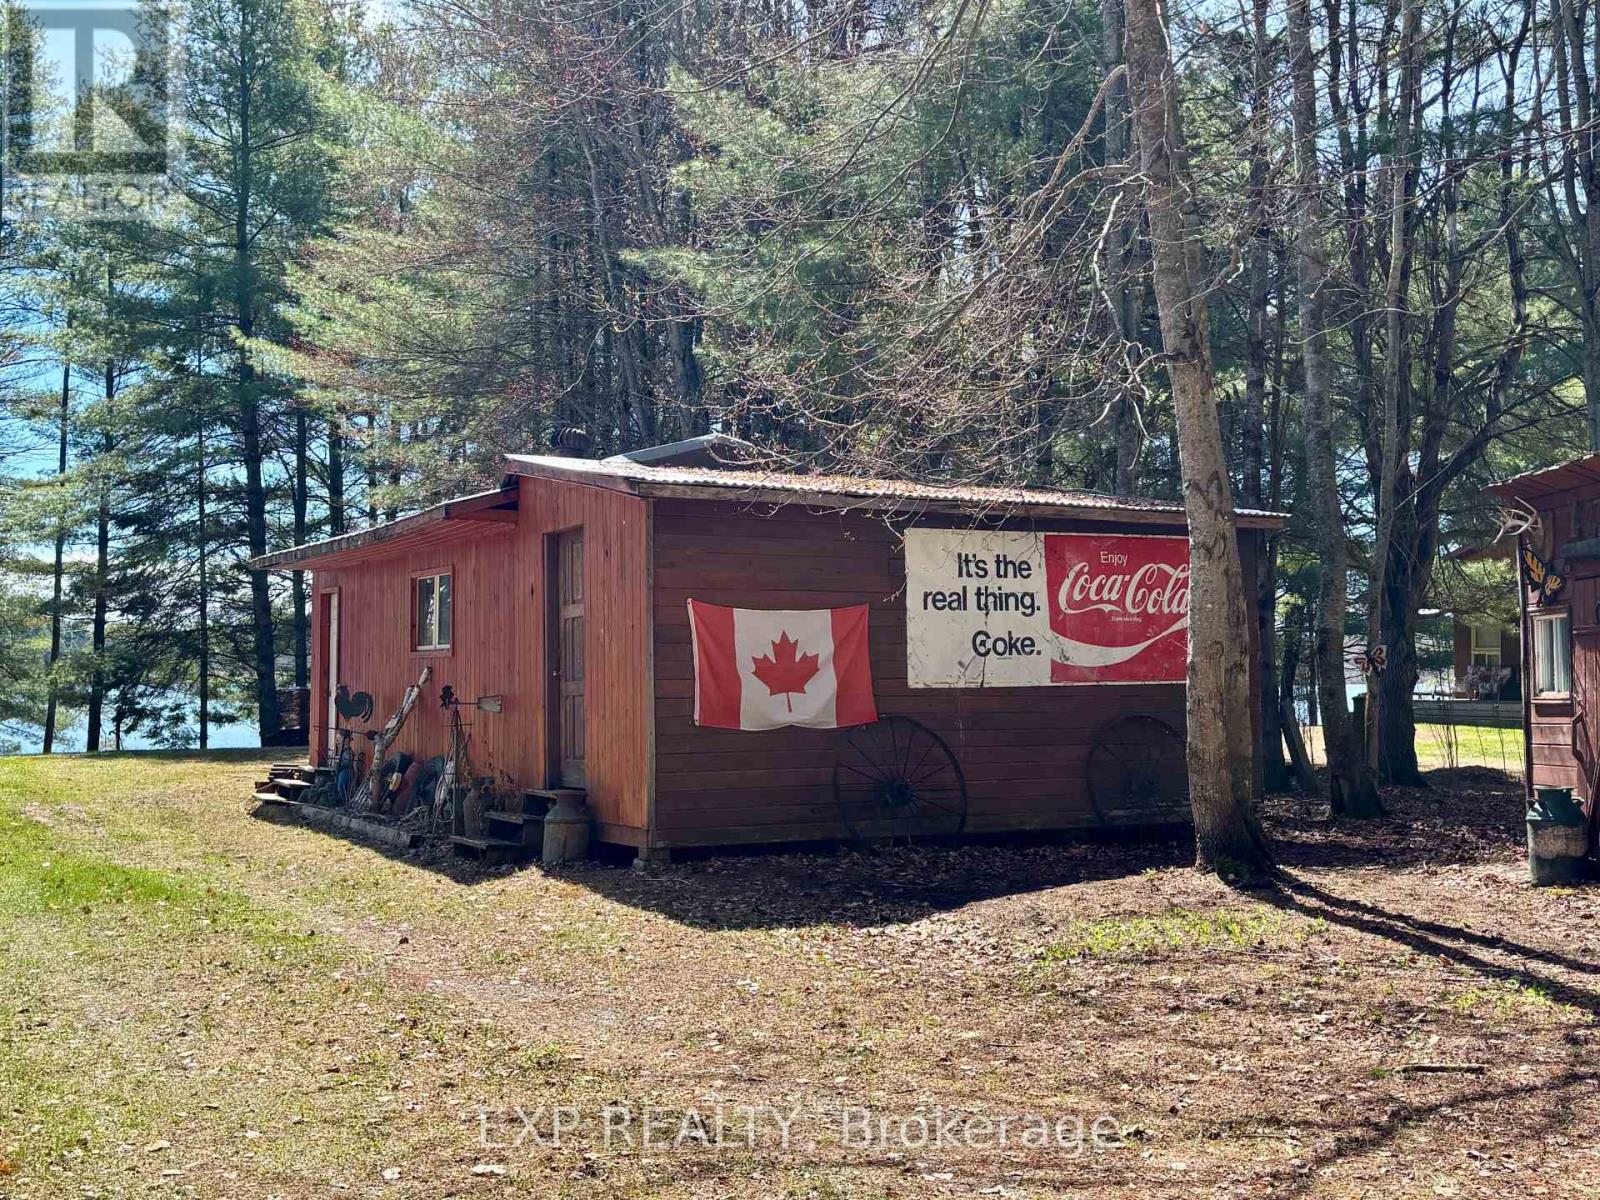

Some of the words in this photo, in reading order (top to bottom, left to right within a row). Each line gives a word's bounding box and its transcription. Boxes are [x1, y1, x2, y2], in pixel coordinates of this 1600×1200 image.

[957, 552, 989, 578] It's
[995, 553, 1032, 579] the
[1099, 551, 1128, 566] Enjoy
[923, 586, 967, 611] real
[975, 586, 1041, 617] thing.
[972, 630, 1041, 657] Coke.
